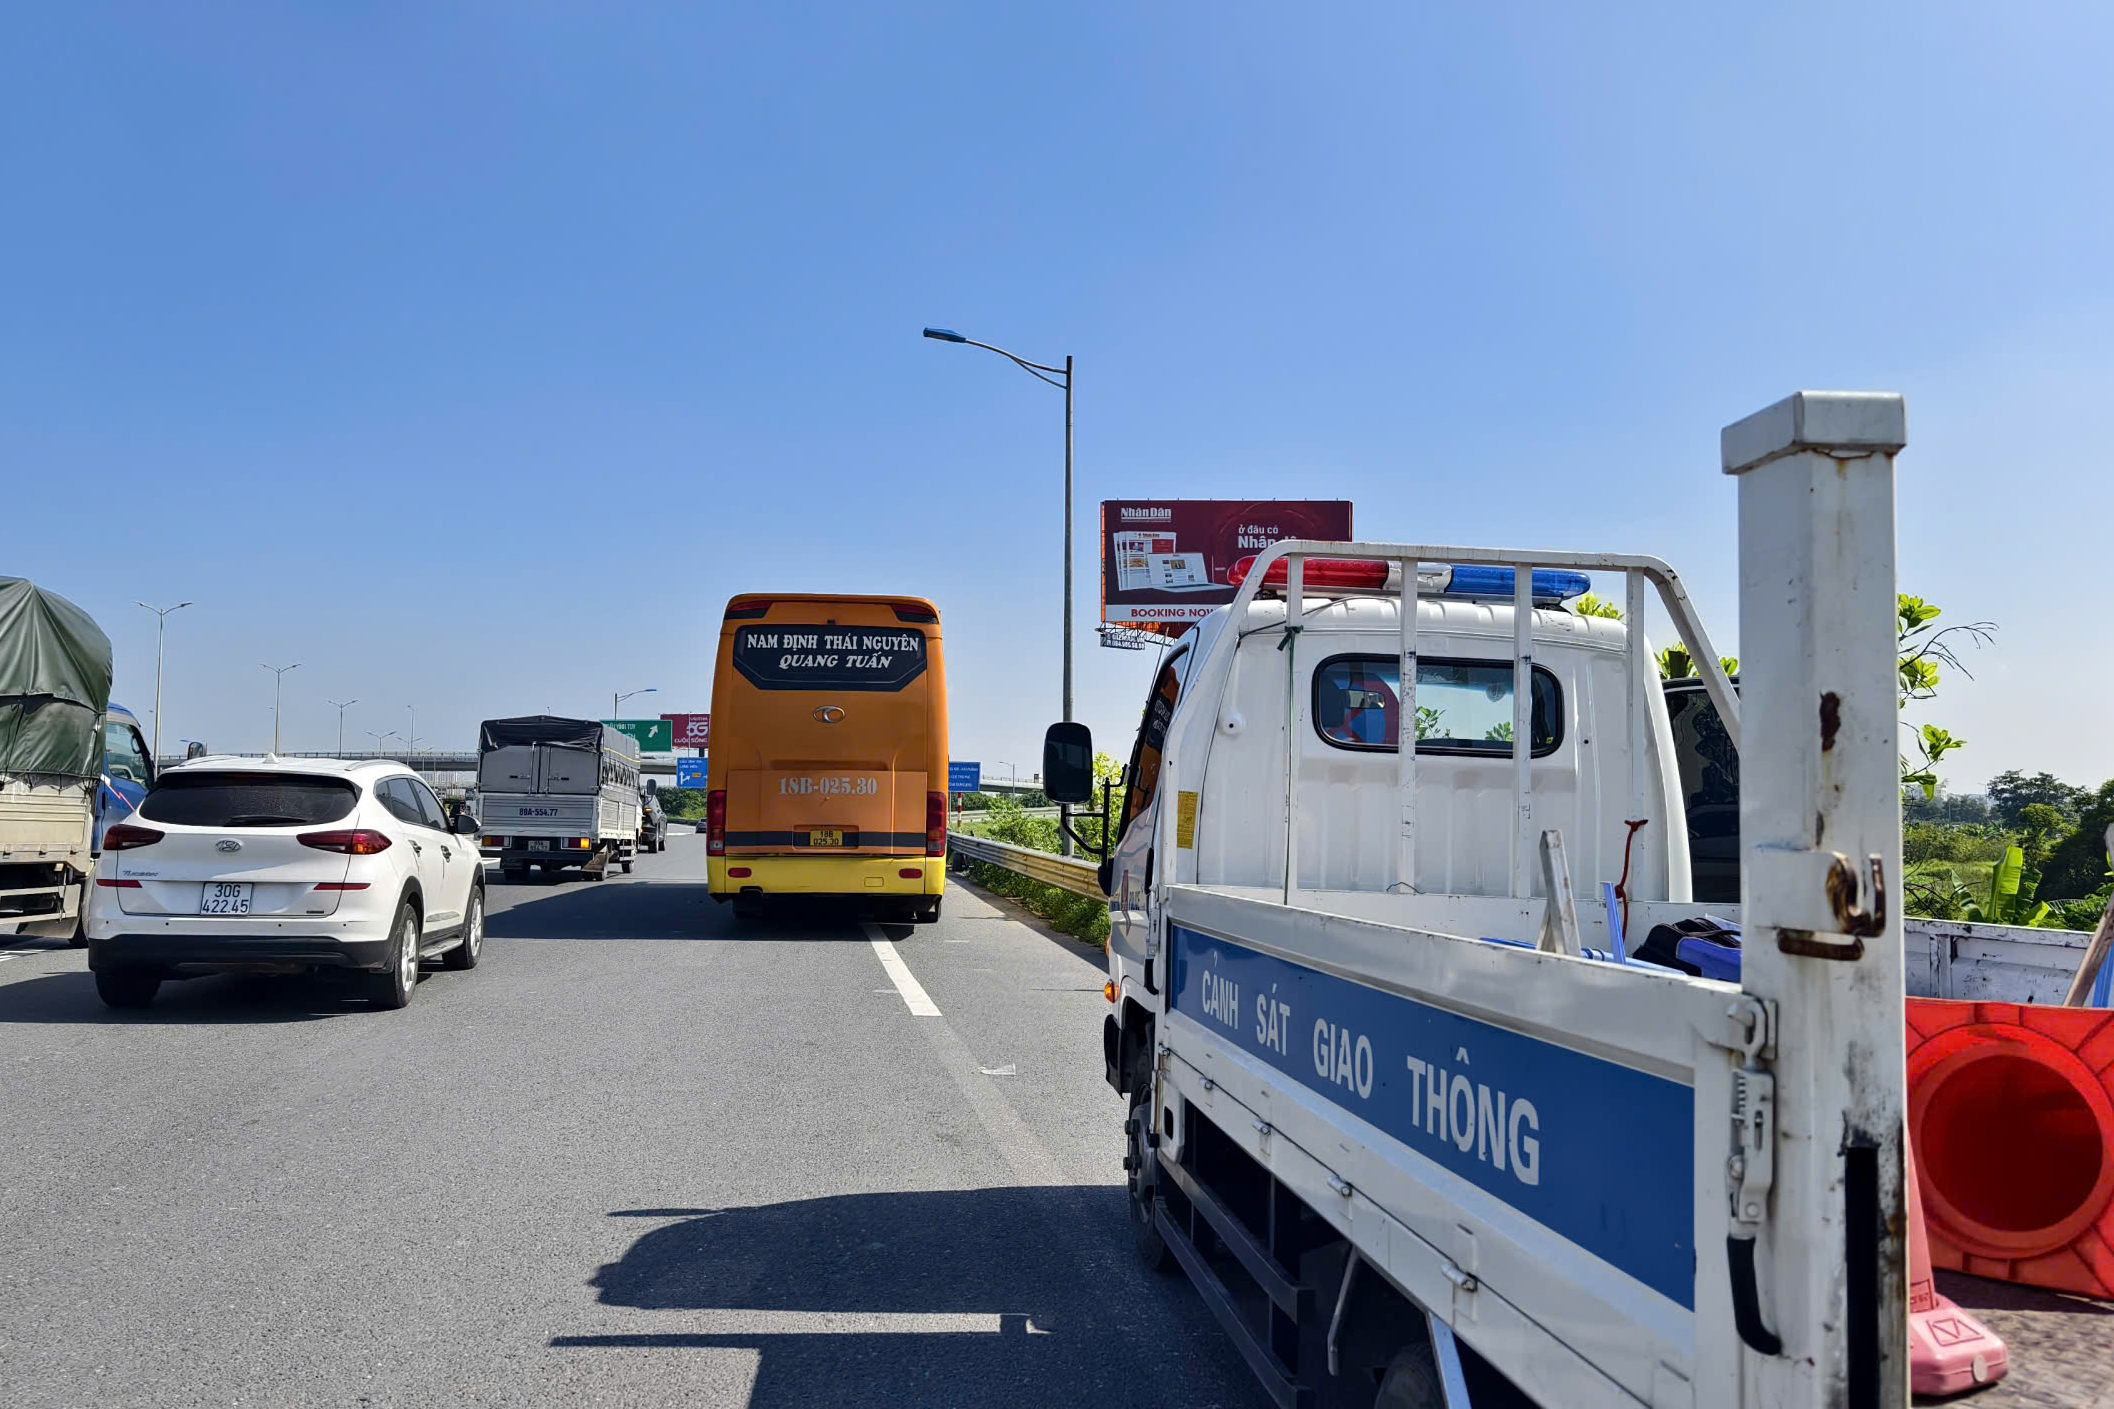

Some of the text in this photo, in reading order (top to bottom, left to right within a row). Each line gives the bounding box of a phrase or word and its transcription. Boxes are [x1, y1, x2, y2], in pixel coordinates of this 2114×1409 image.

[1121, 507, 1172, 517] Nhân Dân
[1238, 524, 1279, 534] ở đâu có
[1131, 608, 1185, 617] BOOKING
[747, 633, 919, 651] NAM ĐỊNH THÁI NGUYÊN
[779, 652, 892, 669] QUANG TUẤN
[686, 722, 709, 736] 5G
[778, 777, 878, 795] 18B-025.30
[214, 884, 241, 898] 30G
[202, 899, 249, 914] 422.45
[1202, 951, 1540, 1186] CẢNH SÁT GIAO THÔNG
